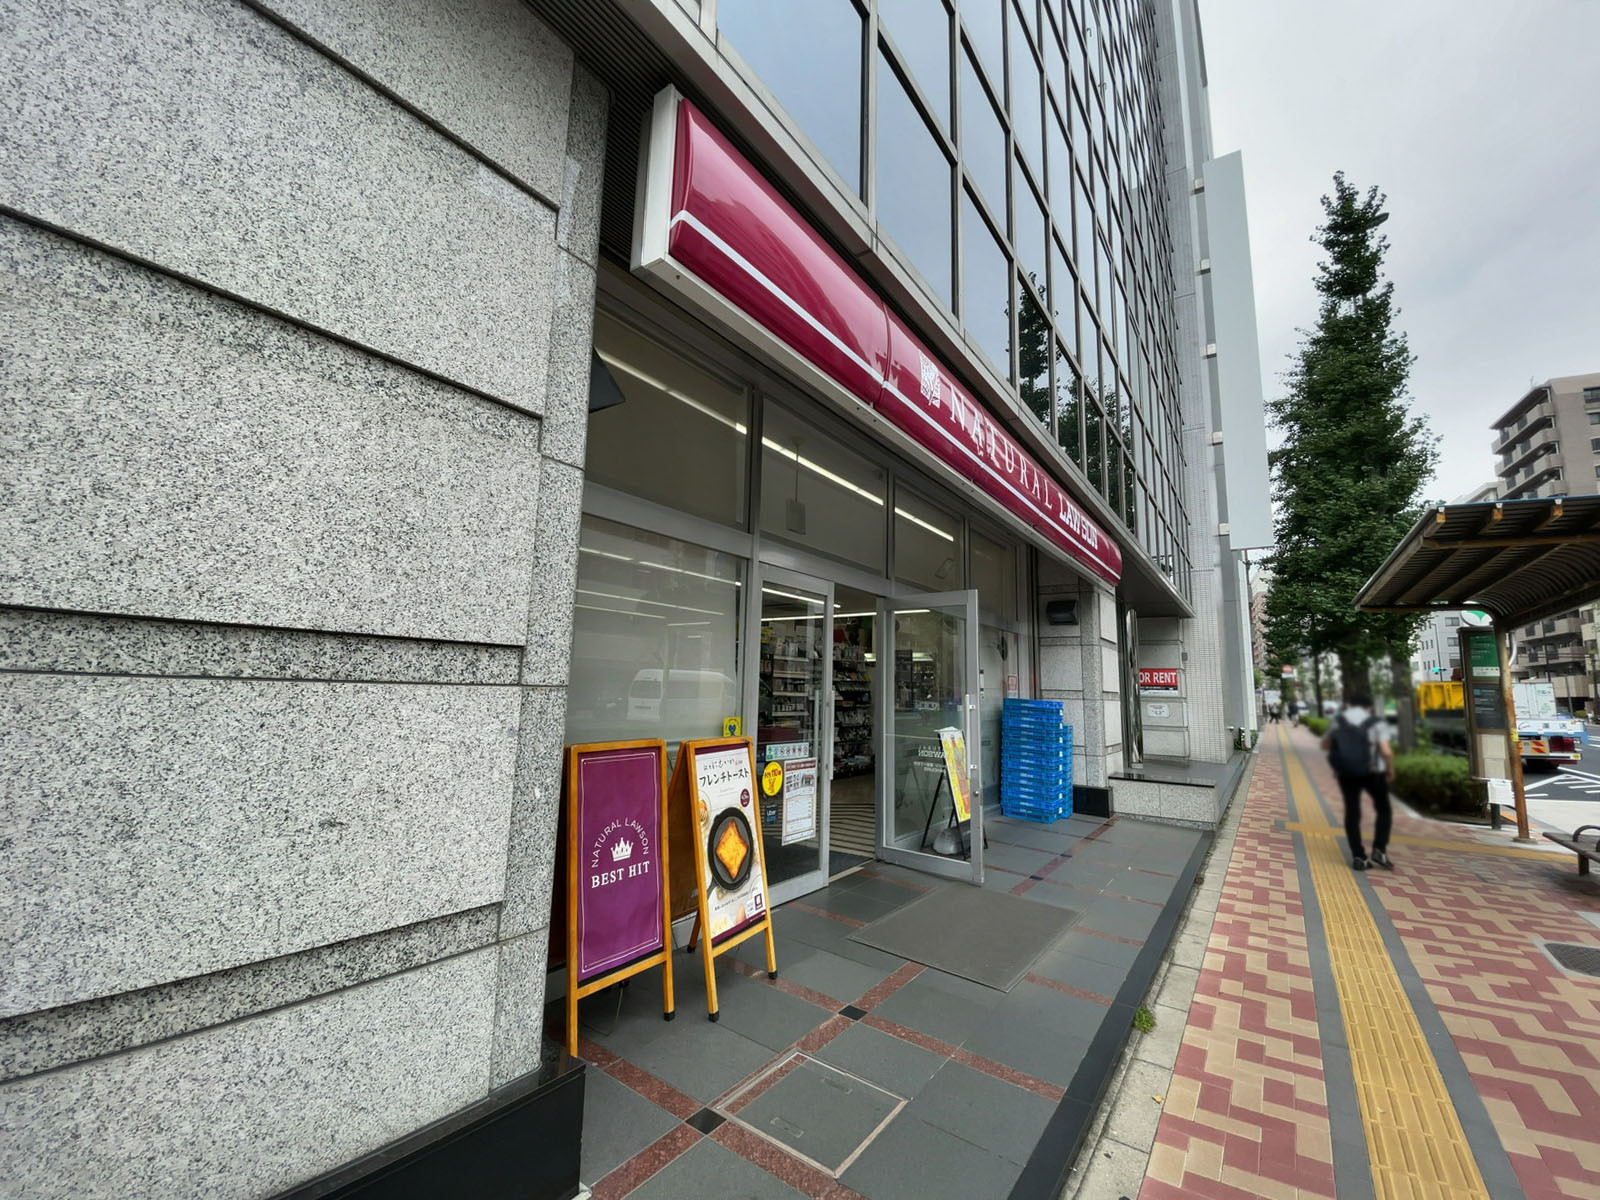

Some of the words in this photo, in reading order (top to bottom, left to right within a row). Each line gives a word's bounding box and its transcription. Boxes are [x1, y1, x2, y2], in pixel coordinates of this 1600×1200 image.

[950, 382, 1052, 509] NATURAL
[1058, 492, 1098, 551] LAWSON
[1139, 672, 1151, 684] OR
[1153, 672, 1177, 684] RENT
[699, 767, 750, 788] フレンチトースト
[591, 819, 622, 868] NATURAL
[624, 817, 650, 855] LAWSON
[591, 868, 624, 889] BEST
[628, 861, 650, 878] HIT
